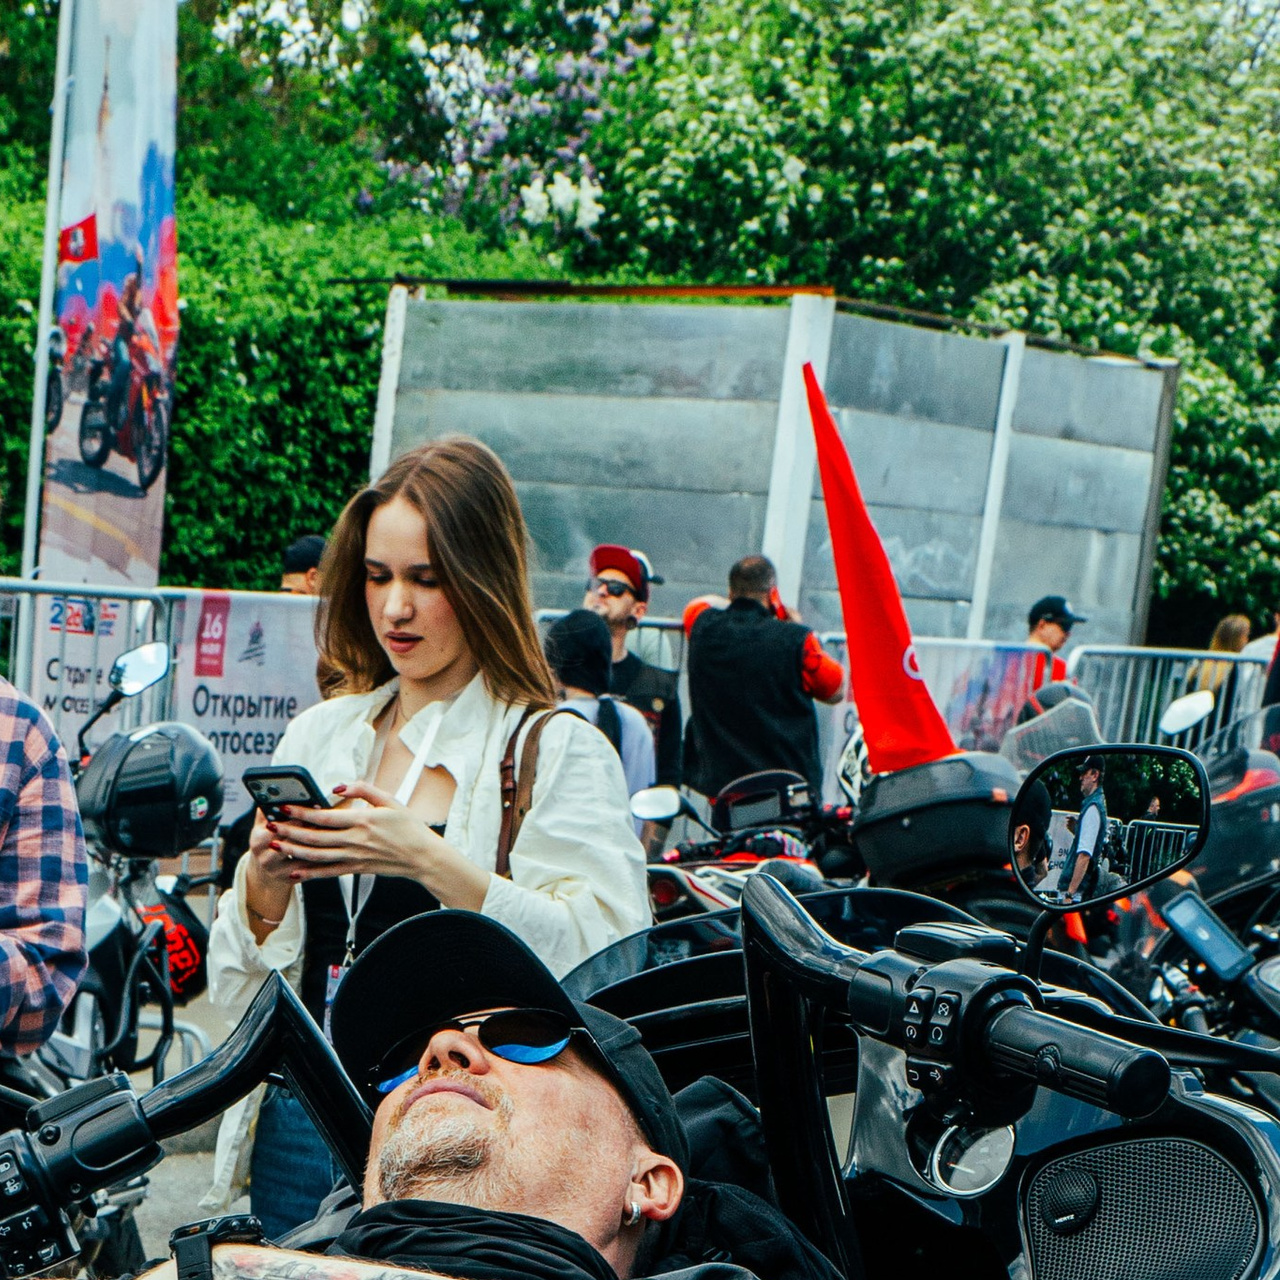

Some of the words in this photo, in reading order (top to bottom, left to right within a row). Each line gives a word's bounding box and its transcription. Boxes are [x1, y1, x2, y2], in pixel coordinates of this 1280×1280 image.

[202, 613, 223, 639] 16
[193, 684, 297, 725] Открытие
[202, 731, 284, 755] отосез
